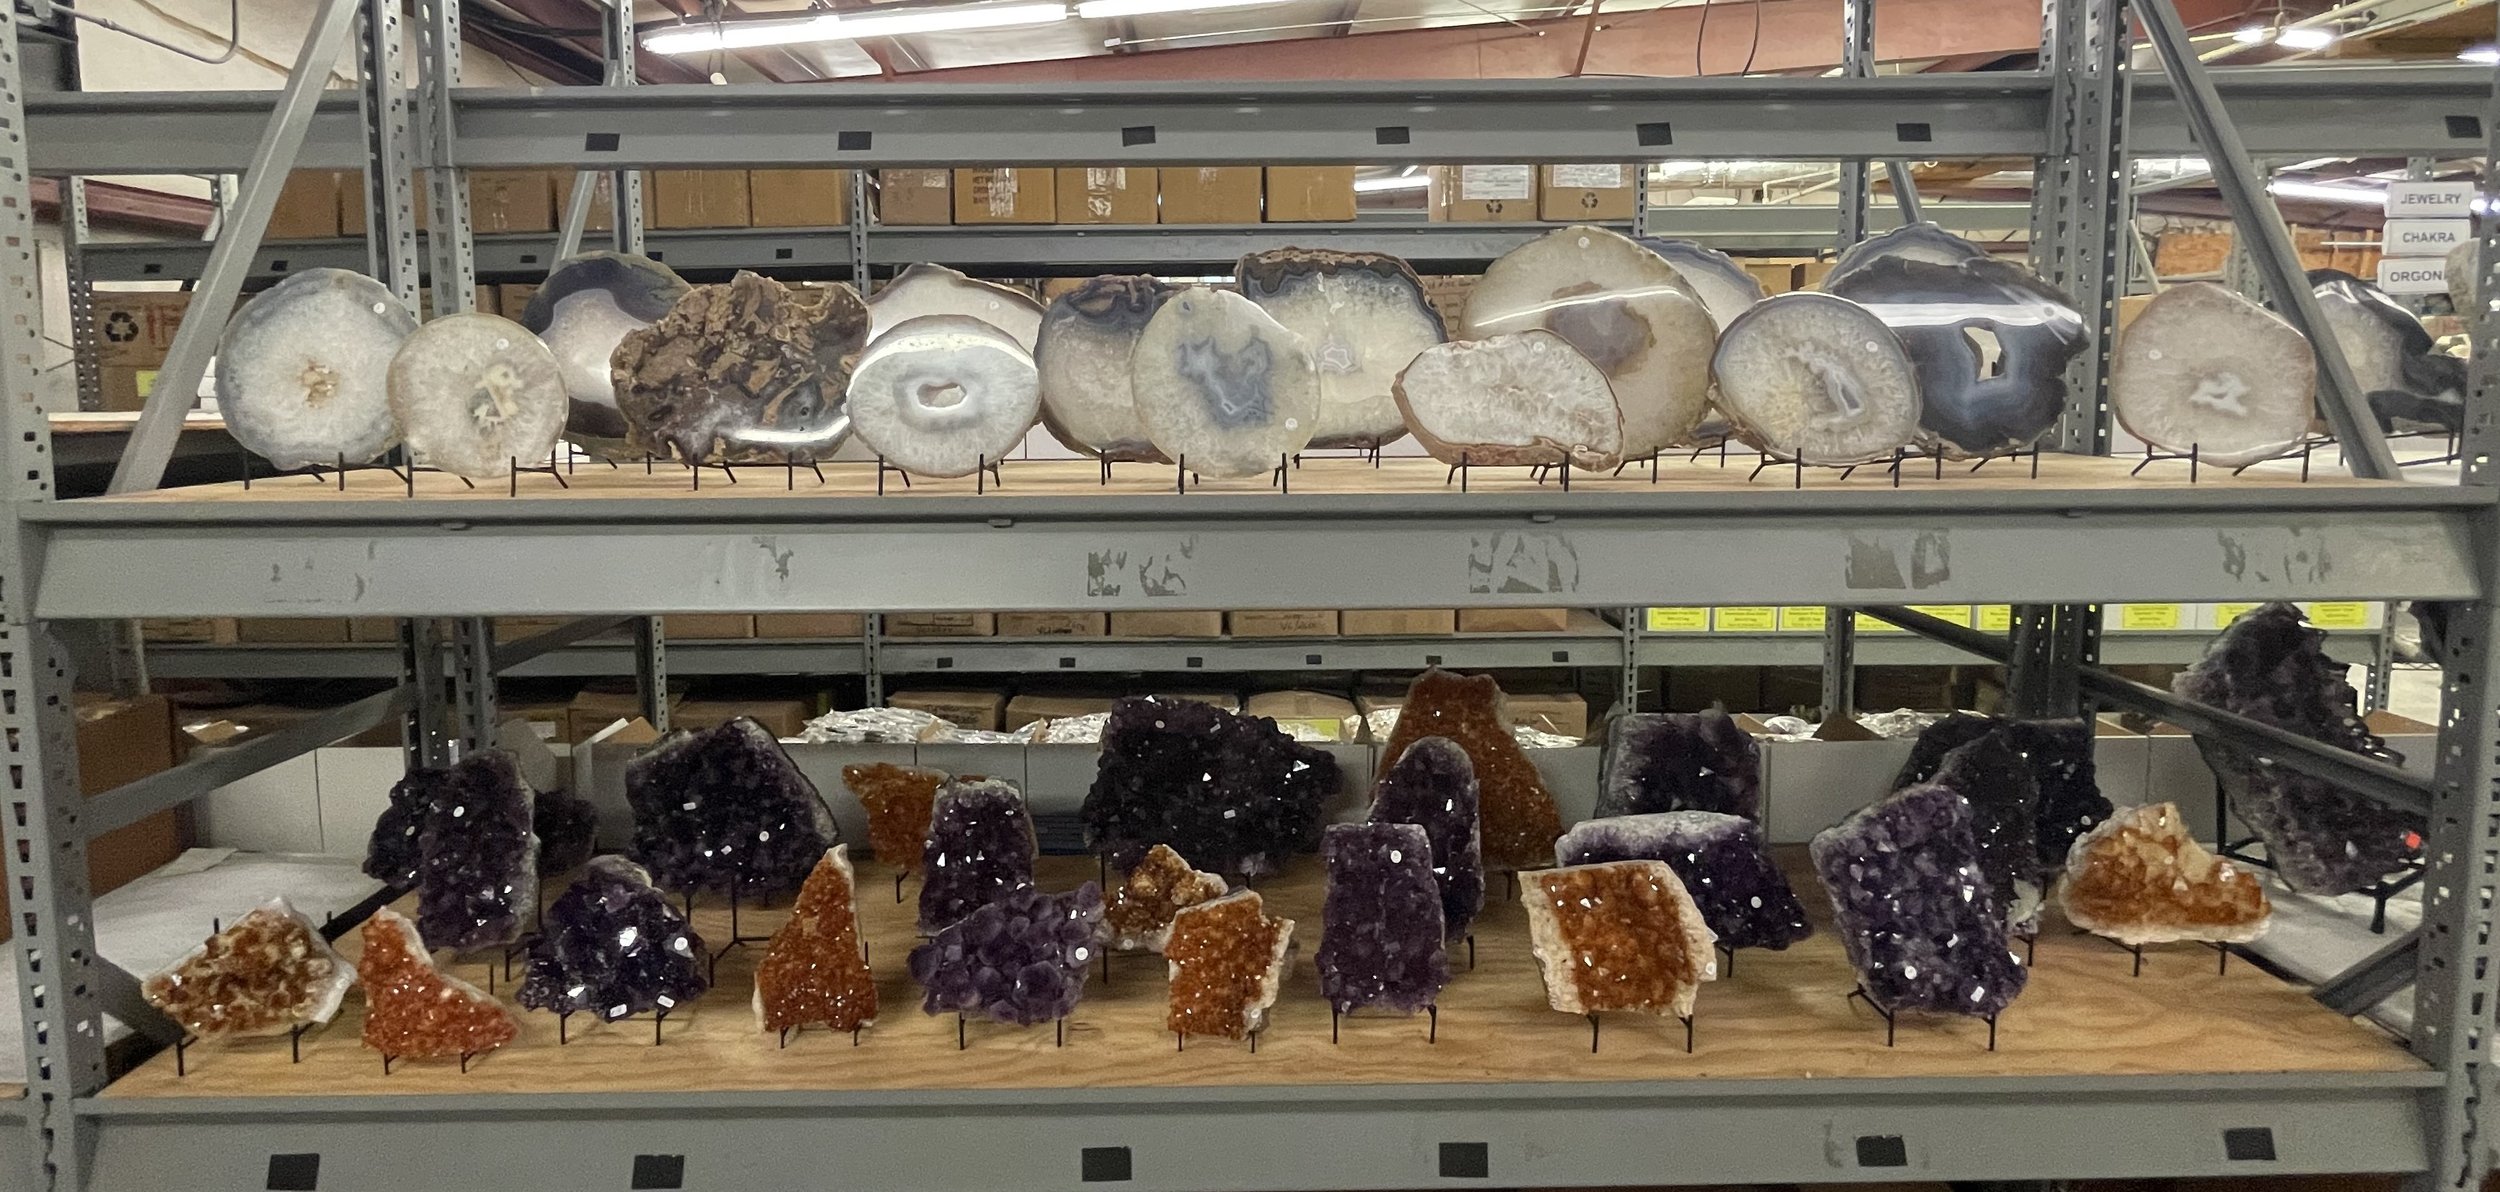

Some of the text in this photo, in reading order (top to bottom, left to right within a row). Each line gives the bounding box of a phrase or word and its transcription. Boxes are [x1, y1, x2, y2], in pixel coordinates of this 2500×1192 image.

[2401, 193, 2461, 204] JEWELRY
[2403, 232, 2456, 243] CHAKRA
[2391, 270, 2447, 282] ORGON
